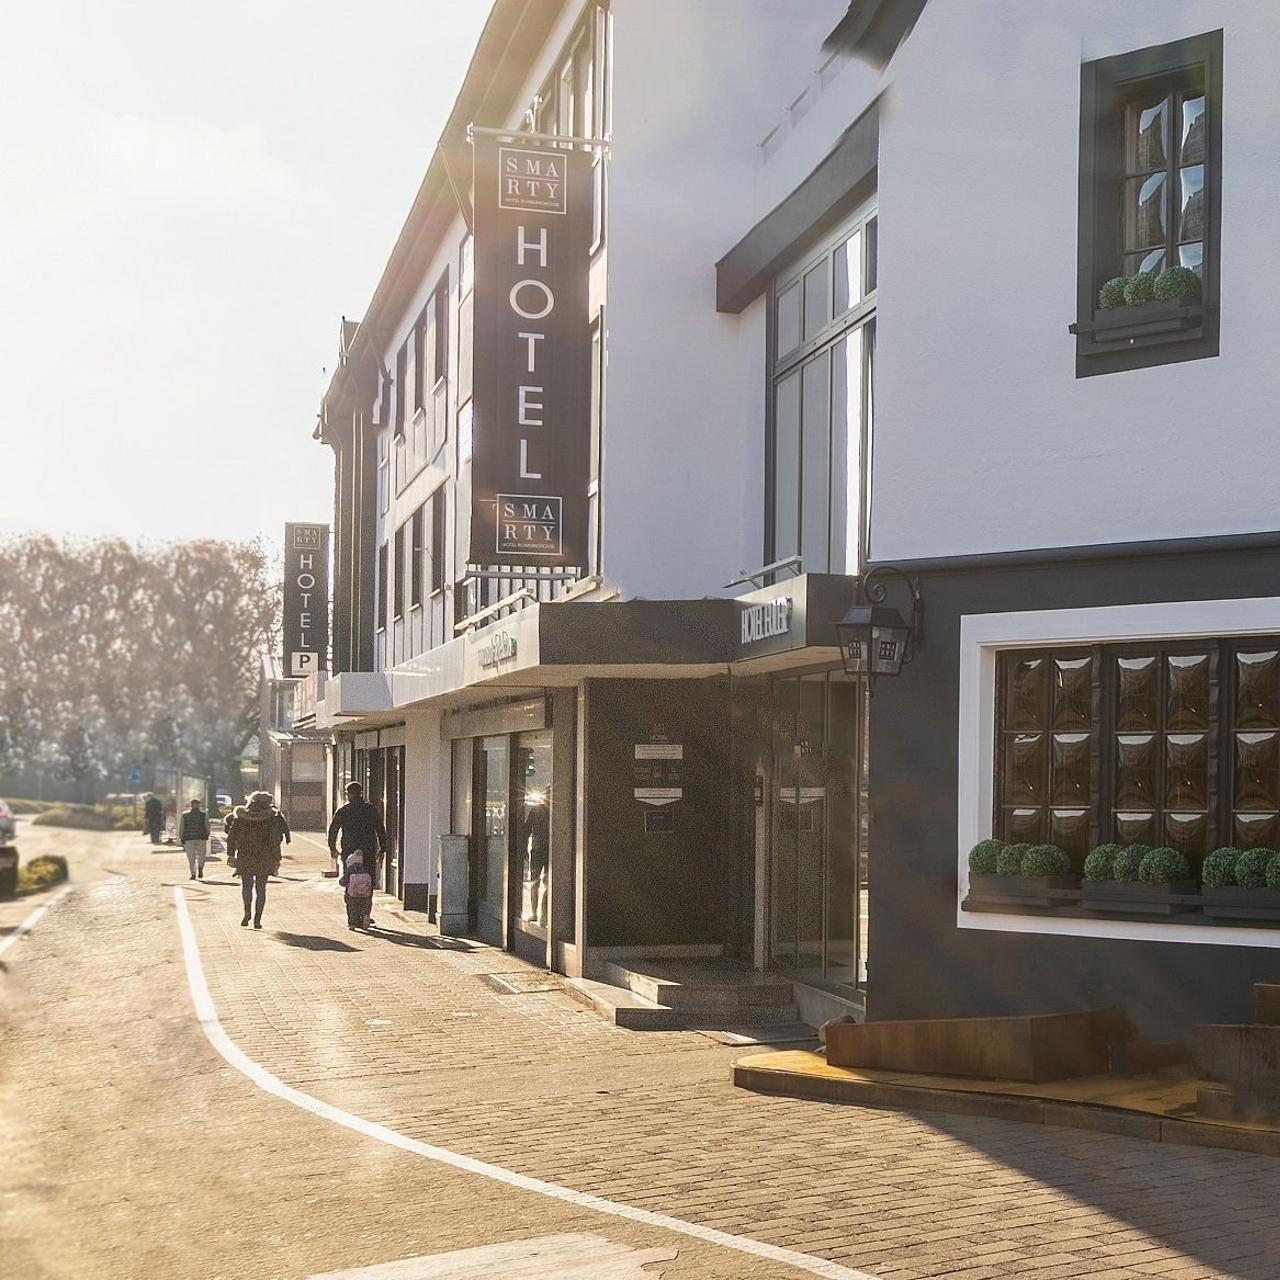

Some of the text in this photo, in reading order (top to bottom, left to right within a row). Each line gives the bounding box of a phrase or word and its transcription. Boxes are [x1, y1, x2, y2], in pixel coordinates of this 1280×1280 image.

[506, 157, 560, 178] SMA
[507, 179, 560, 199] RTY
[509, 225, 555, 479] HOTEL
[504, 502, 555, 520] SMA
[503, 523, 555, 541] RTY
[297, 554, 316, 648] HOTEL
[741, 605, 765, 644] HOTEL
[299, 654, 311, 669] P
